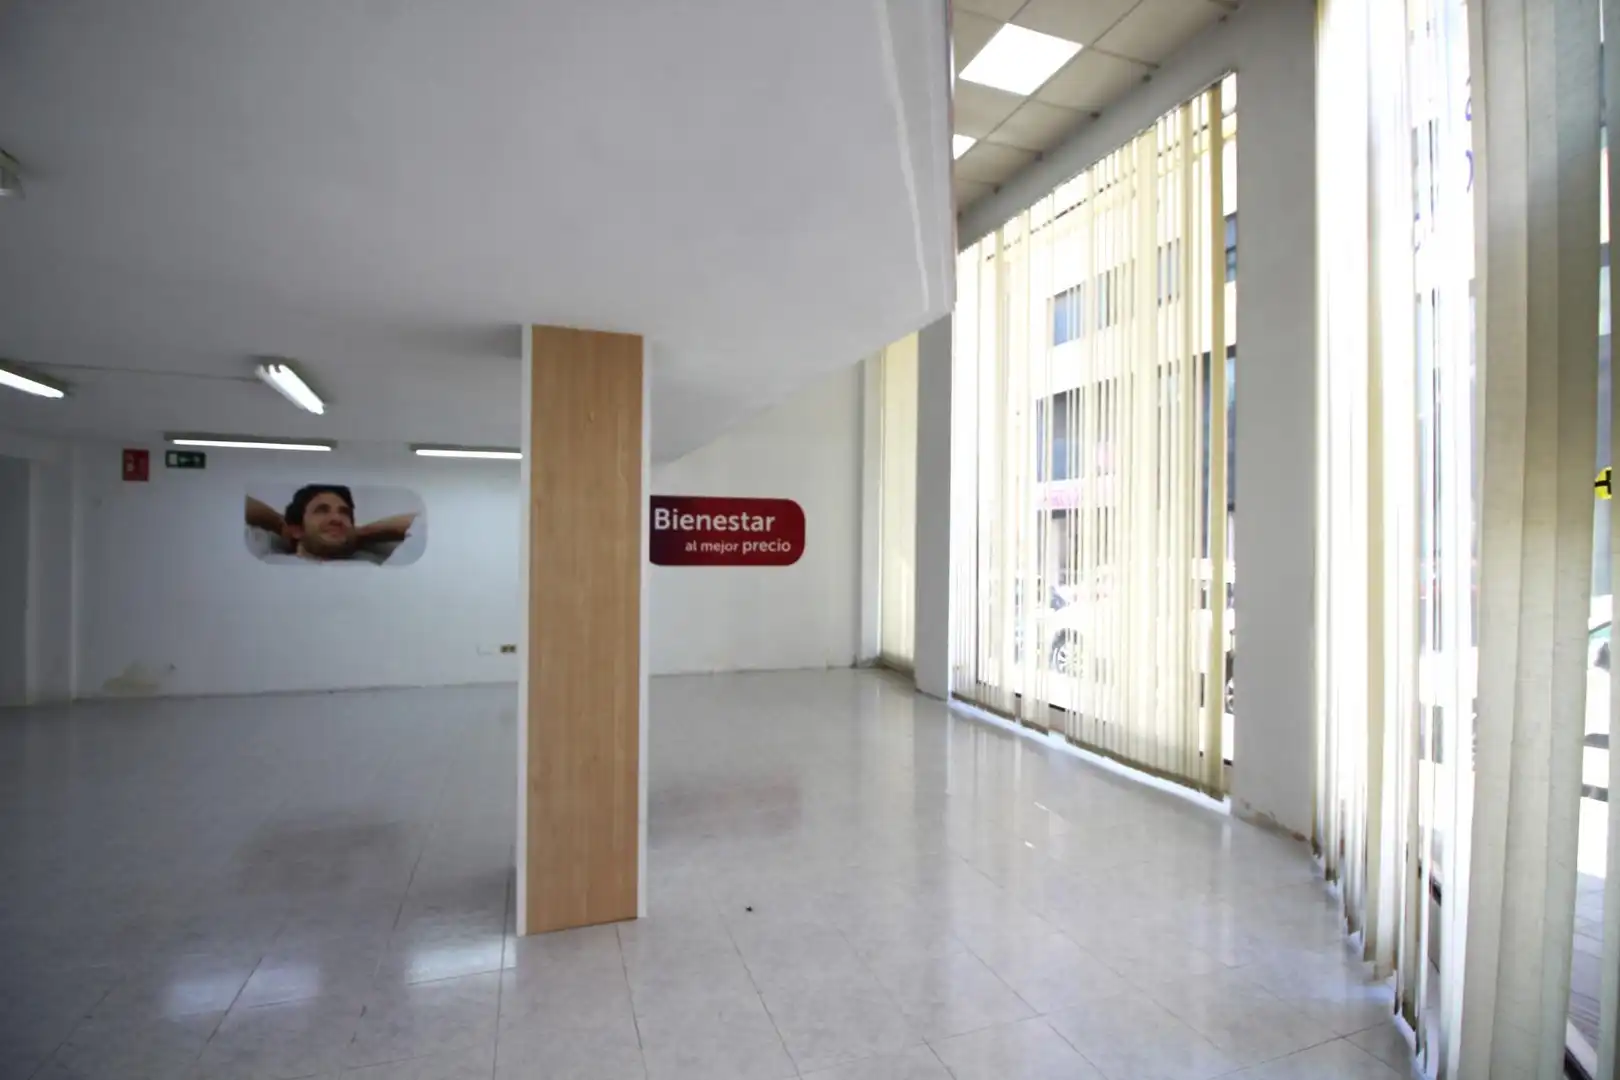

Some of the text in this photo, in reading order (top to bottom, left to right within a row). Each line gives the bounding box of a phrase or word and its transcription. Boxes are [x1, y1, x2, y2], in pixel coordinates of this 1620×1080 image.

[653, 507, 777, 533] Bienestar
[685, 538, 792, 555] al mejor precio
